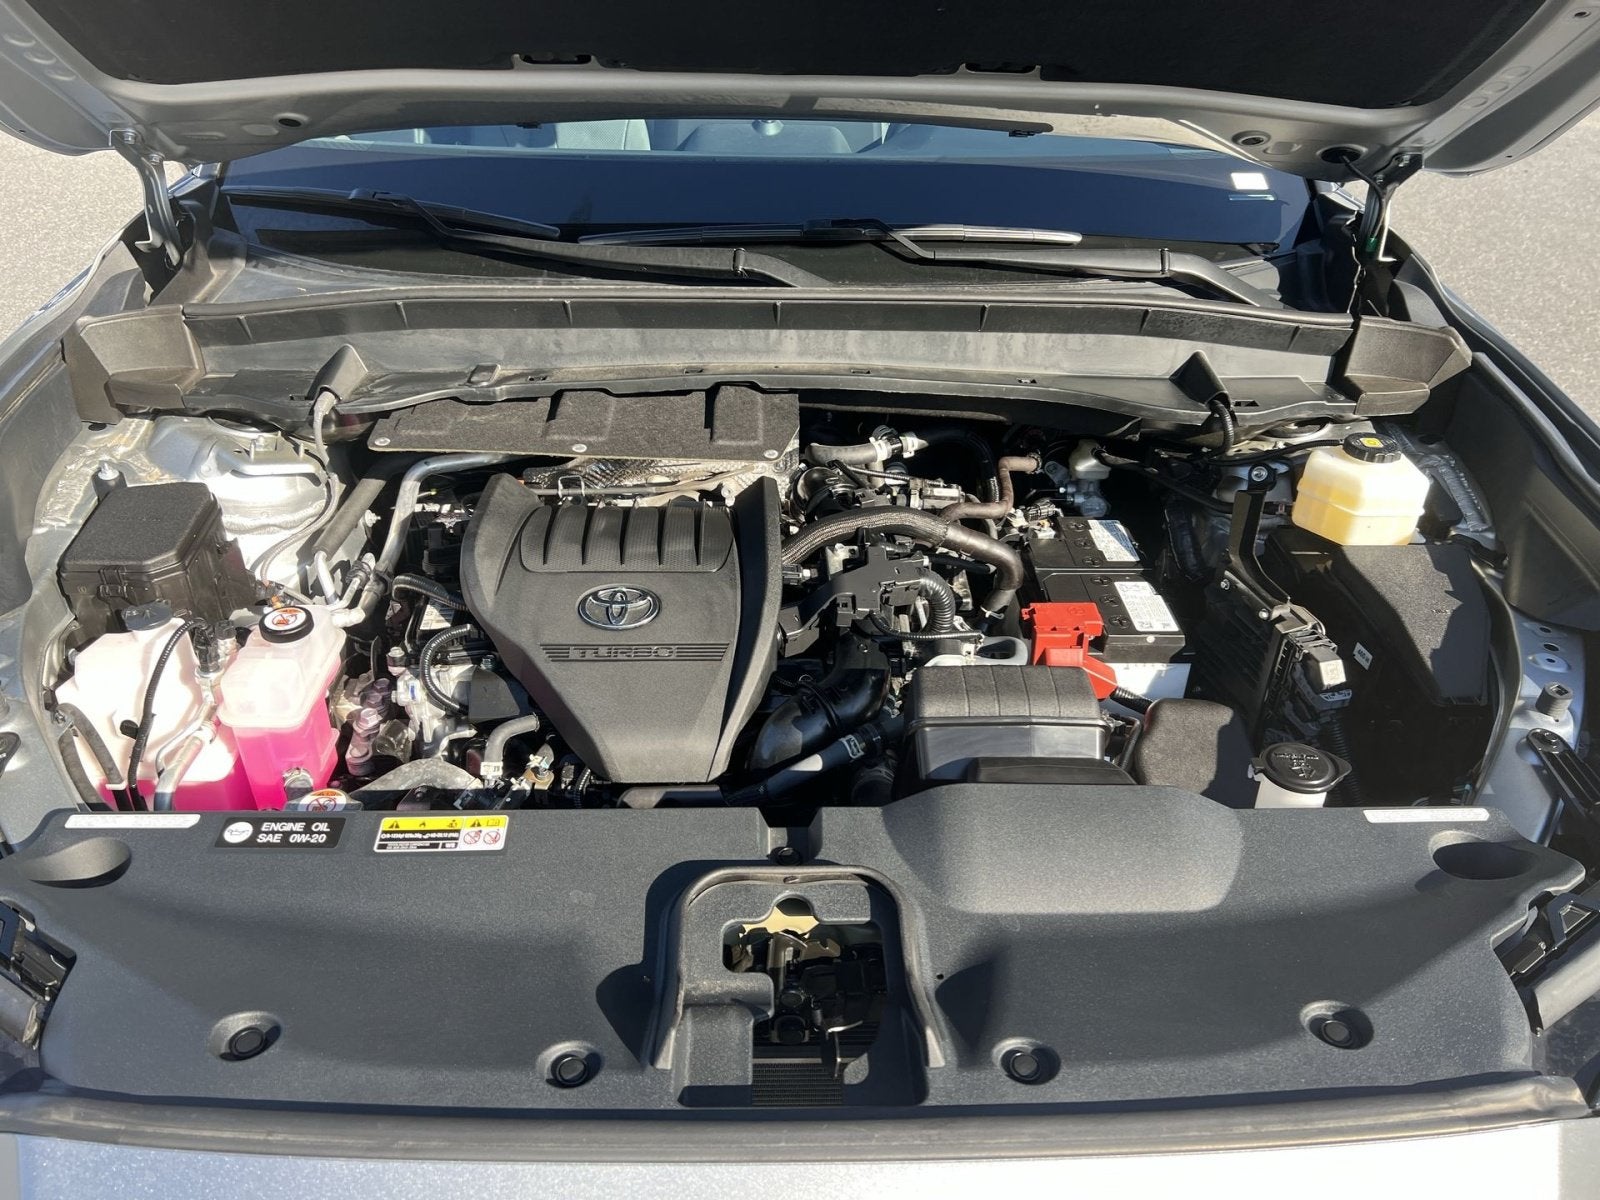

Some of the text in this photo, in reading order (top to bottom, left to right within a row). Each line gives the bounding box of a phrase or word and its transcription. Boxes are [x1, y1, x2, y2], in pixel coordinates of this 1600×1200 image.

[572, 646, 674, 658] TURBO
[261, 822, 331, 832] ENGINE OIL
[256, 833, 327, 843] SAE 0W-20
